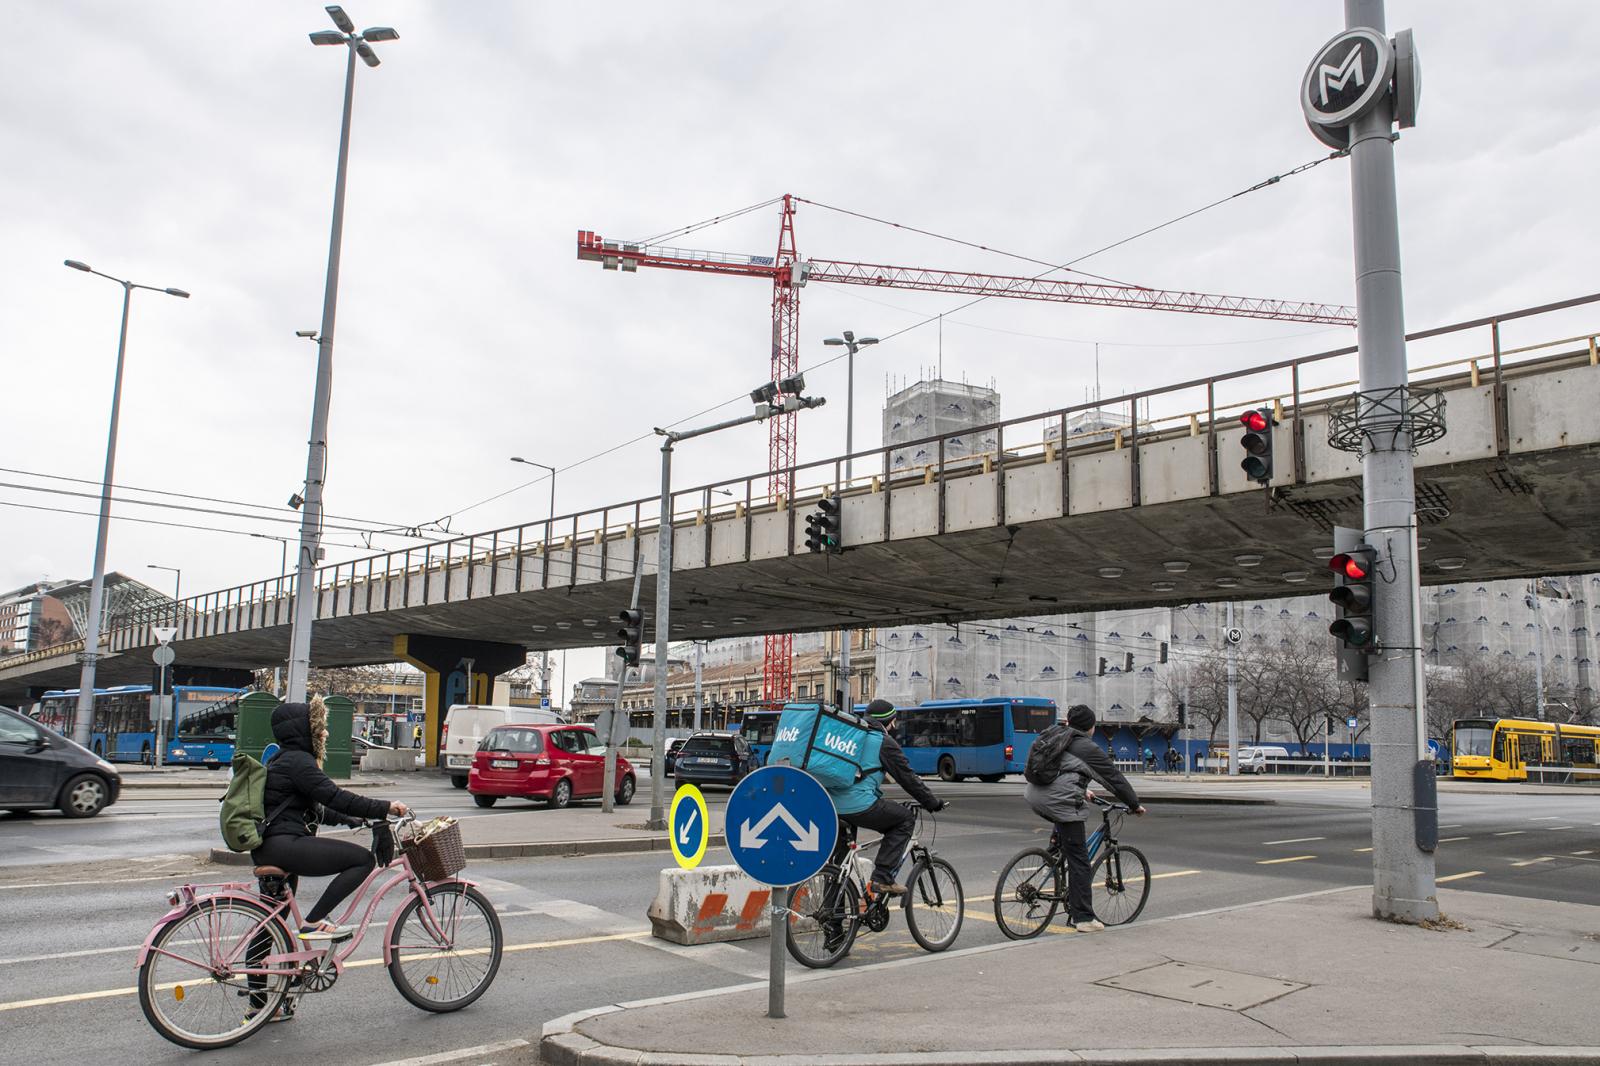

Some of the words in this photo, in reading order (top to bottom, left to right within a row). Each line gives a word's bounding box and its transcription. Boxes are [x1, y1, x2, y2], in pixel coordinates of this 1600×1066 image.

[1318, 42, 1365, 106] M
[775, 726, 801, 742] Wolt
[824, 731, 858, 757] Wolt
